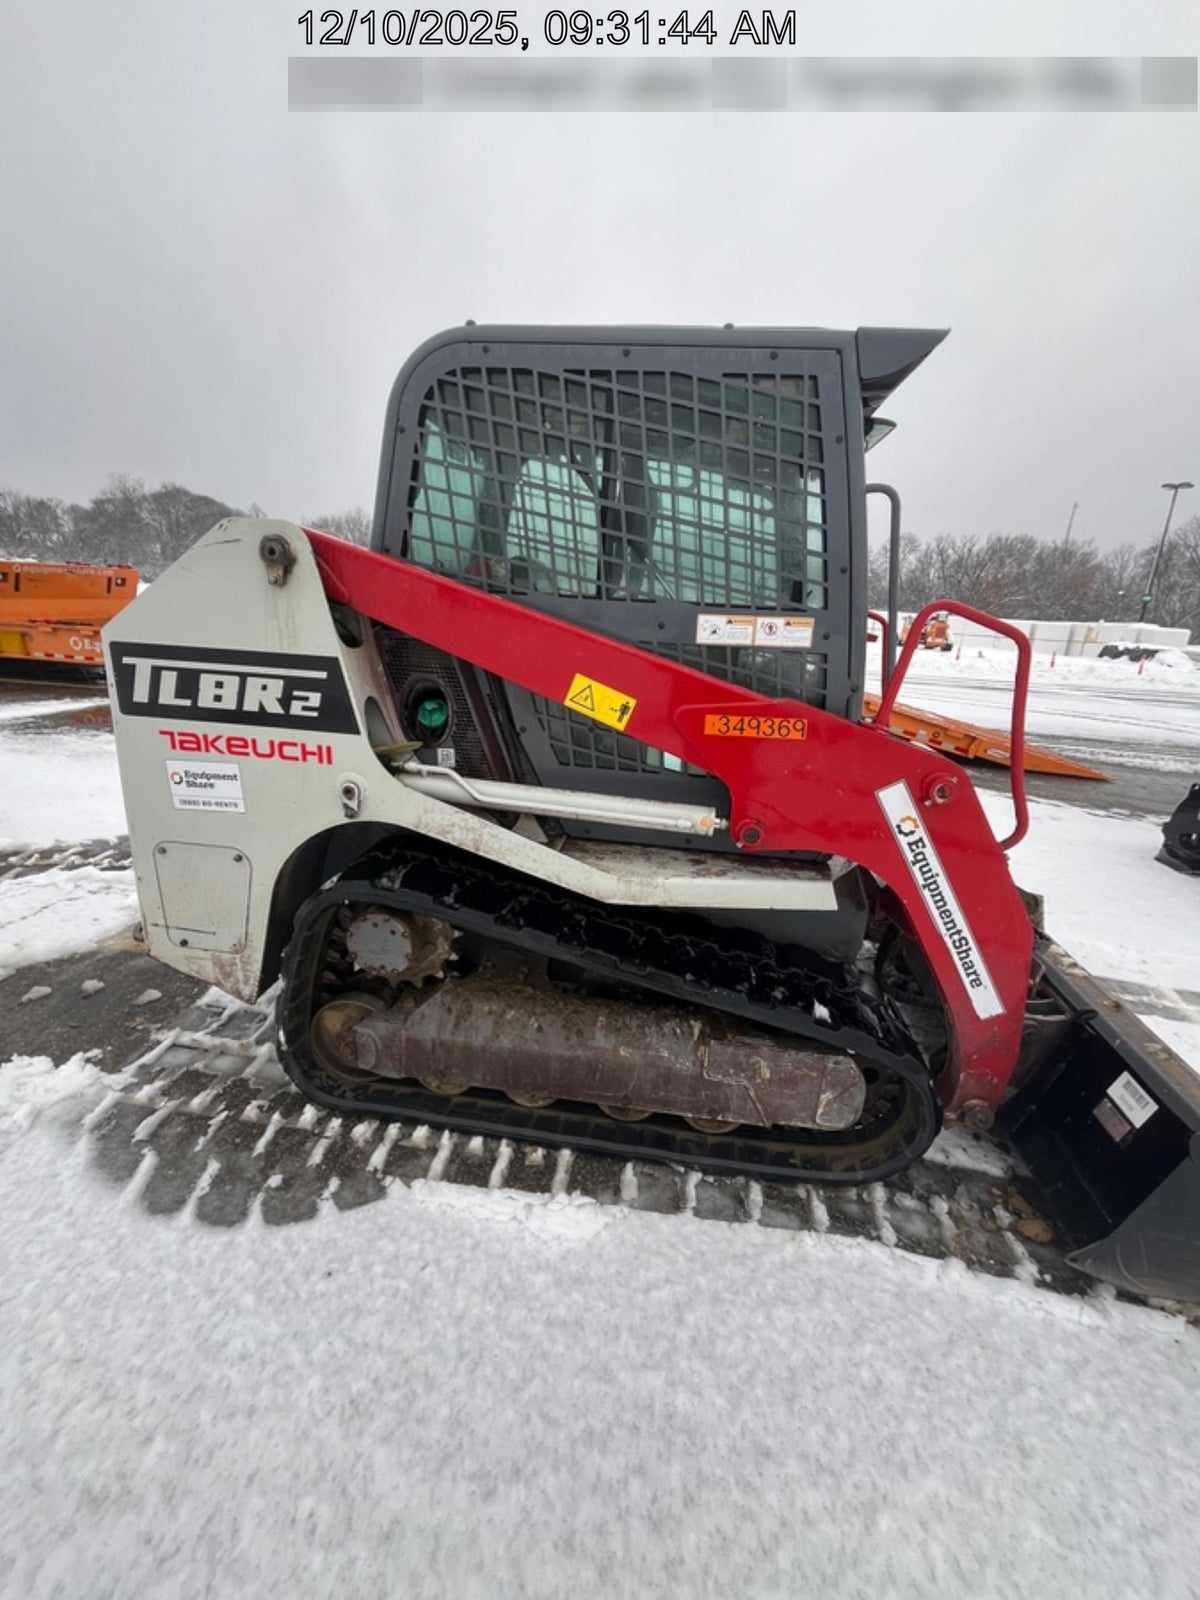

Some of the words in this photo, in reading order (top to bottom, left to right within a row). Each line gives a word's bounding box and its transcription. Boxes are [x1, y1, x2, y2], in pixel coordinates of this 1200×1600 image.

[122, 656, 327, 717] TL8R2
[717, 715, 806, 738] 349369
[184, 769, 239, 781] Equipment
[185, 780, 215, 789] Share
[906, 835, 983, 989] EquipmentShare
